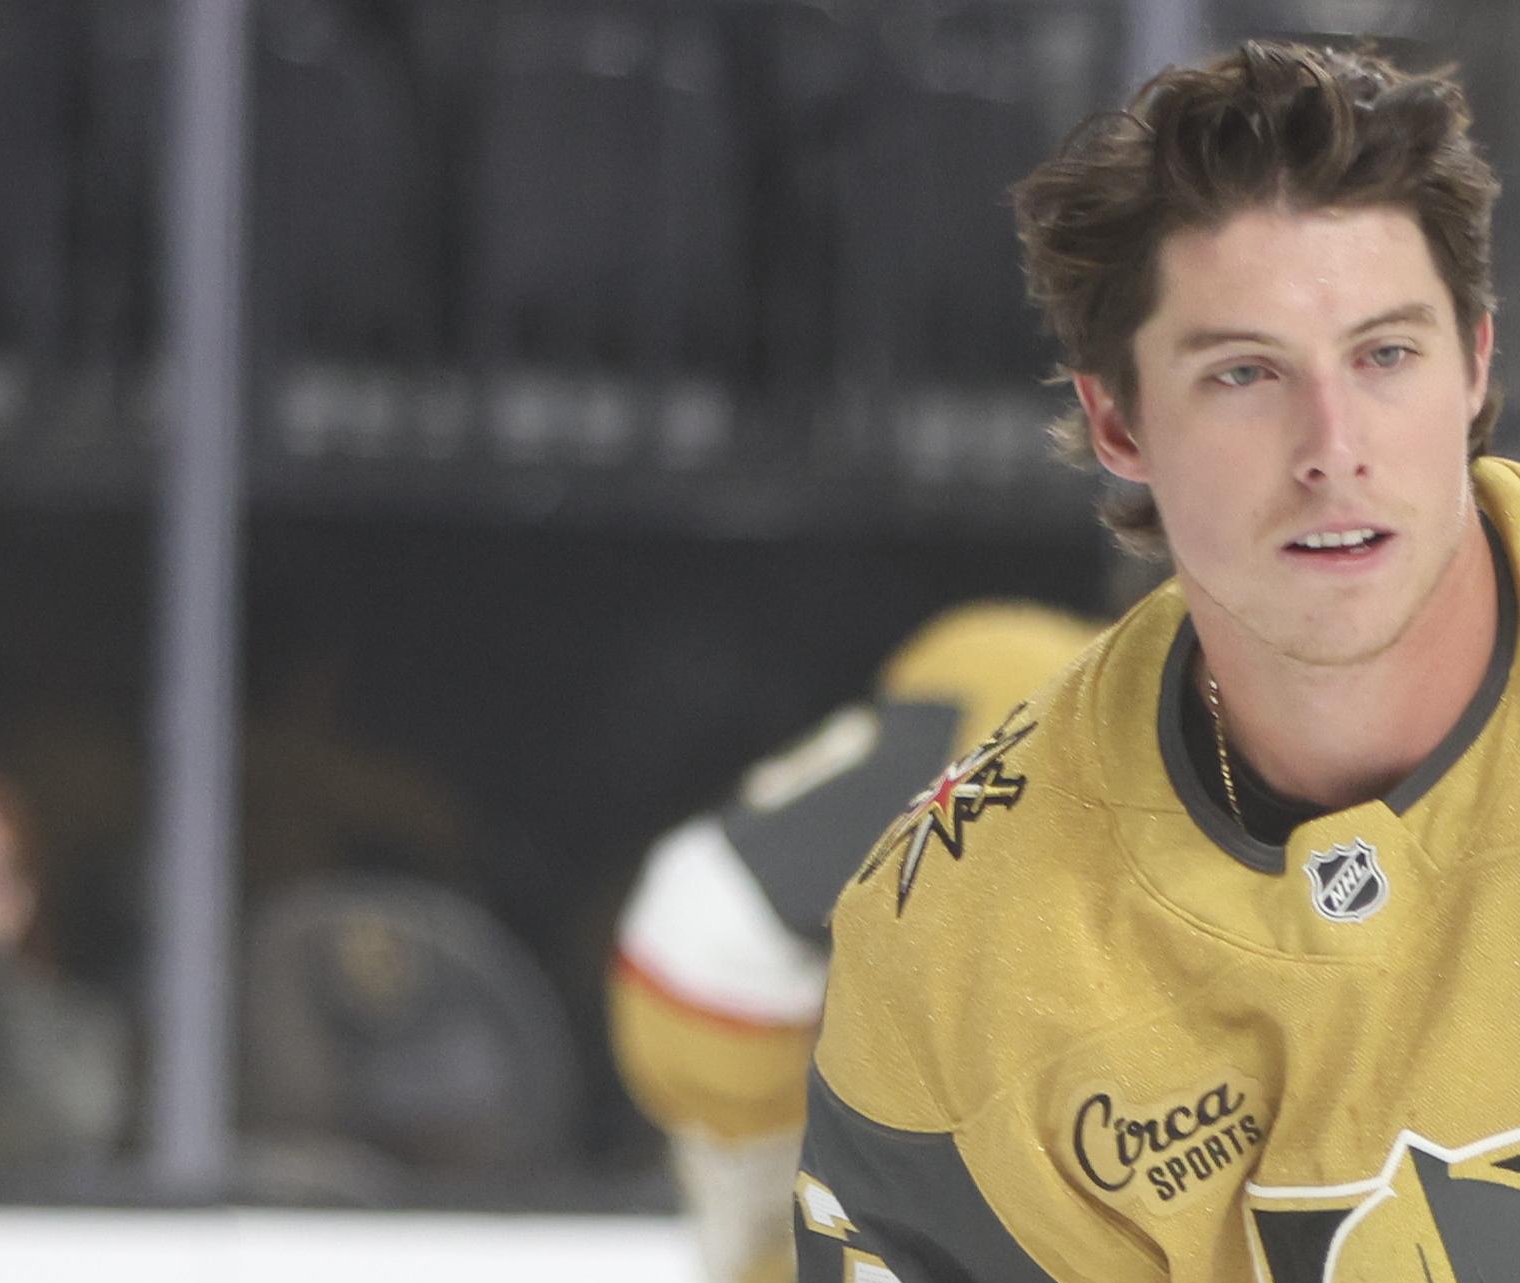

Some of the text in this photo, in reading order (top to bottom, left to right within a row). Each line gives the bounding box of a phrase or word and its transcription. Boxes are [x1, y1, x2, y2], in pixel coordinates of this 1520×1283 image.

[1329, 857, 1371, 912] NHL
[1072, 1083, 1245, 1192] Circa
[1147, 1115, 1263, 1201] SPORTS
